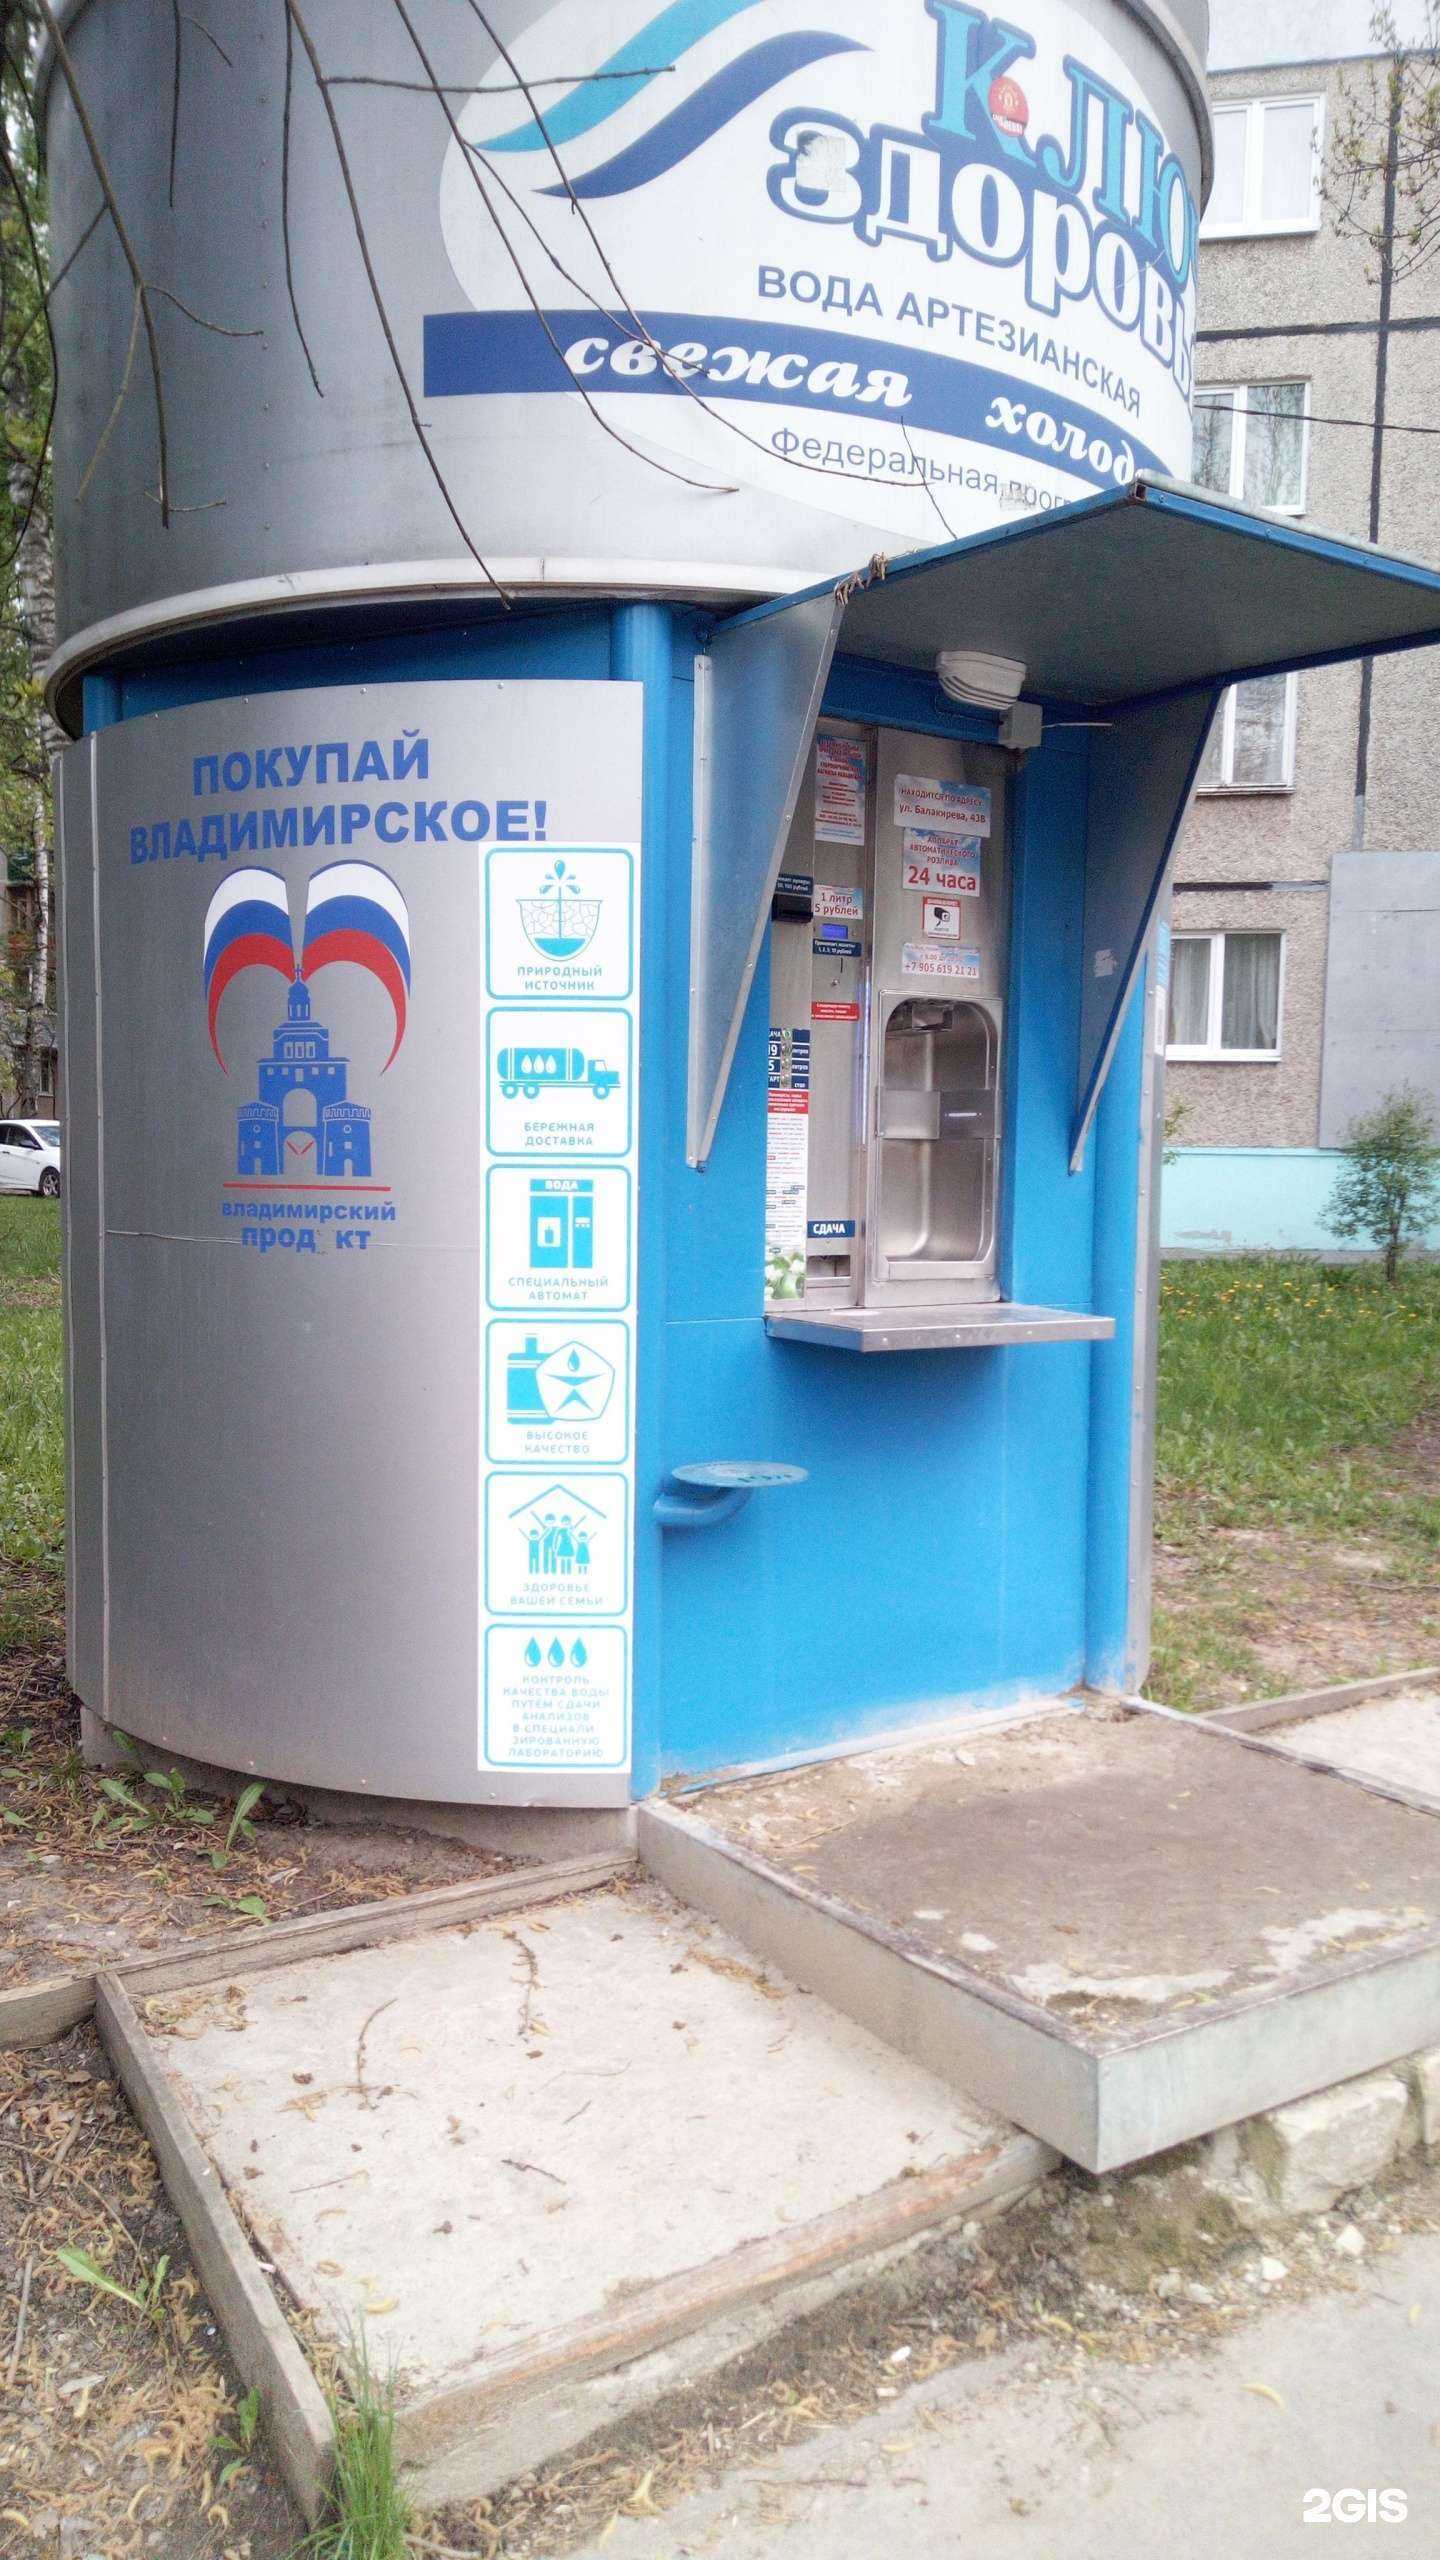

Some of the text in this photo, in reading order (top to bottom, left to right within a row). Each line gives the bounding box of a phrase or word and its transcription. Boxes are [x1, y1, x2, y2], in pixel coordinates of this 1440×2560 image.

[922, 0, 1199, 292] КЛЮ
[758, 265, 1141, 419] ВОДА АРТЕЗИАНСКАЯ
[563, 336, 1143, 485] свежая холод
[771, 428, 998, 494] Федеральная
[193, 728, 429, 796] ПОКУПАЙ
[129, 799, 548, 866] ВЛАДИМИРСКОЕ!
[908, 865, 976, 891] 24 часа
[821, 893, 853, 905] 1 литр
[815, 903, 859, 916] 5 рублей
[516, 963, 603, 978] ПРИРОДНЫЙ
[919, 962, 935, 972] 905
[936, 963, 952, 974] 619
[967, 966, 977, 976] 21
[524, 977, 595, 992] ИСТОЧНИК
[523, 1121, 596, 1134] БЕРЕЖНАЯ
[525, 1134, 594, 1148] ДОСТАВКА
[545, 1180, 579, 1191] ВОДА
[221, 1200, 396, 1223] владимирский
[813, 1223, 846, 1236] СДАЧА
[241, 1226, 372, 1253] продкт
[508, 1275, 609, 1289] СПЕЦИАЛЬНЫЙ
[528, 1290, 589, 1301] АВТОМАТ
[526, 1430, 589, 1441] ВЫСОКОЕ
[524, 1444, 591, 1455] КАЧЕСТВО
[522, 1582, 590, 1594] ЗДОРОВЬЕ
[559, 1596, 604, 1606] СЕМЬИ
[522, 1675, 590, 1685] КОНТРОЛЬ
[503, 1687, 610, 1698] КАЧЕСТВА ВОДЫ
[557, 1700, 601, 1710] СДАЧИ
[522, 1711, 590, 1722] АНАЛИЗОВ
[512, 1724, 520, 1733] В
[512, 1736, 600, 1746] ЗИРОВАННУЮ
[508, 1748, 604, 1758] ЛАБОРАТОРИЮ
